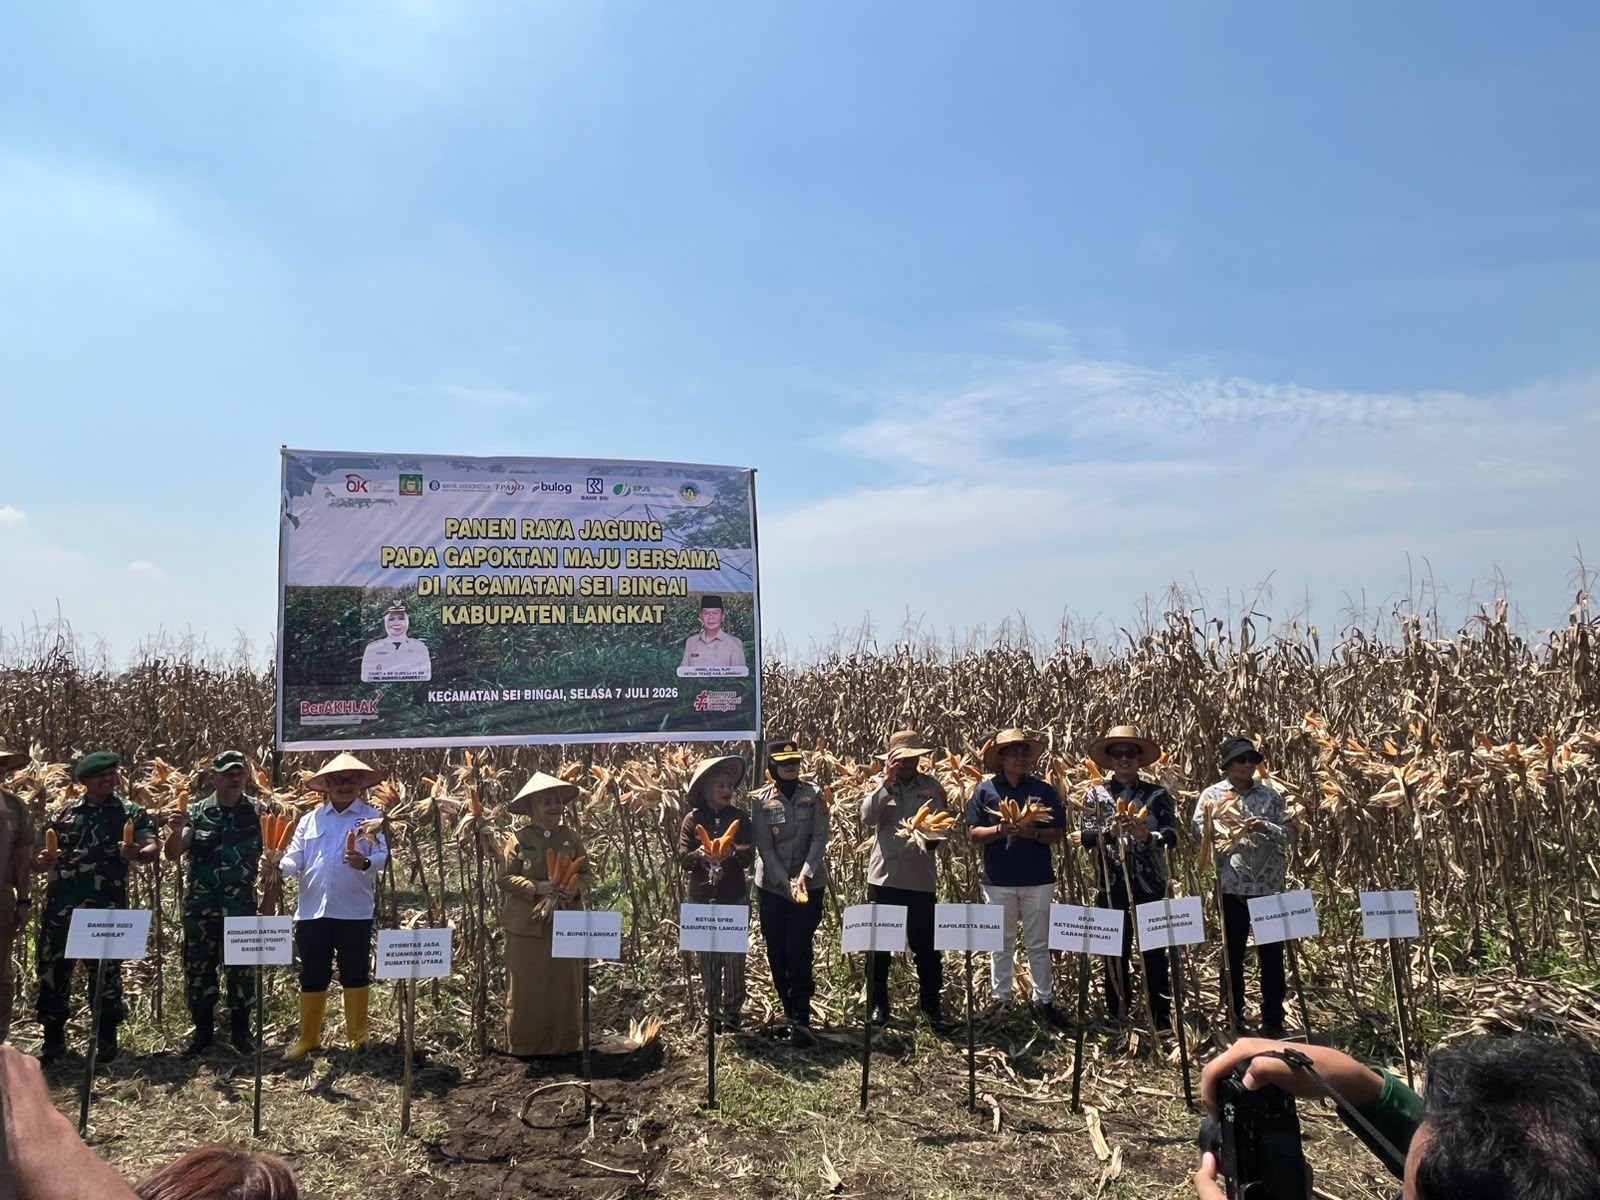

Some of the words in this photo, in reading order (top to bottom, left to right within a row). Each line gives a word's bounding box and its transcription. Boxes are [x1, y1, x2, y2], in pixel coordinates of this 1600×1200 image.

[345, 475, 368, 493] OJK
[541, 482, 572, 494] bulog
[445, 518, 516, 540] PANEN
[521, 519, 575, 540] RAYA
[579, 520, 662, 541] JAGUNG
[381, 546, 439, 568] PADA
[443, 546, 558, 568] GAPOKTAN
[563, 547, 621, 569] MAJU
[626, 548, 721, 570] BERSAMA
[417, 575, 441, 597] DI
[446, 575, 574, 597] KECAMATAN
[579, 576, 613, 597] SEI
[618, 576, 688, 597] BINGAI
[441, 603, 566, 626] KABUPATEN
[572, 603, 665, 626] LANGKAT
[428, 690, 499, 702] KECAMATAN
[502, 690, 521, 701] SEI
[524, 689, 566, 702] BINGAI,
[570, 688, 612, 700] SELASA
[615, 687, 622, 699] 7
[624, 687, 649, 699] JULI
[652, 687, 679, 699] 2026
[300, 699, 379, 715] BerAKHLAK
[1265, 911, 1289, 921] CABANG
[1053, 922, 1119, 933] KETENAGAKERJAAN
[1061, 930, 1088, 938] CABANG
[1147, 923, 1170, 932] CABANG
